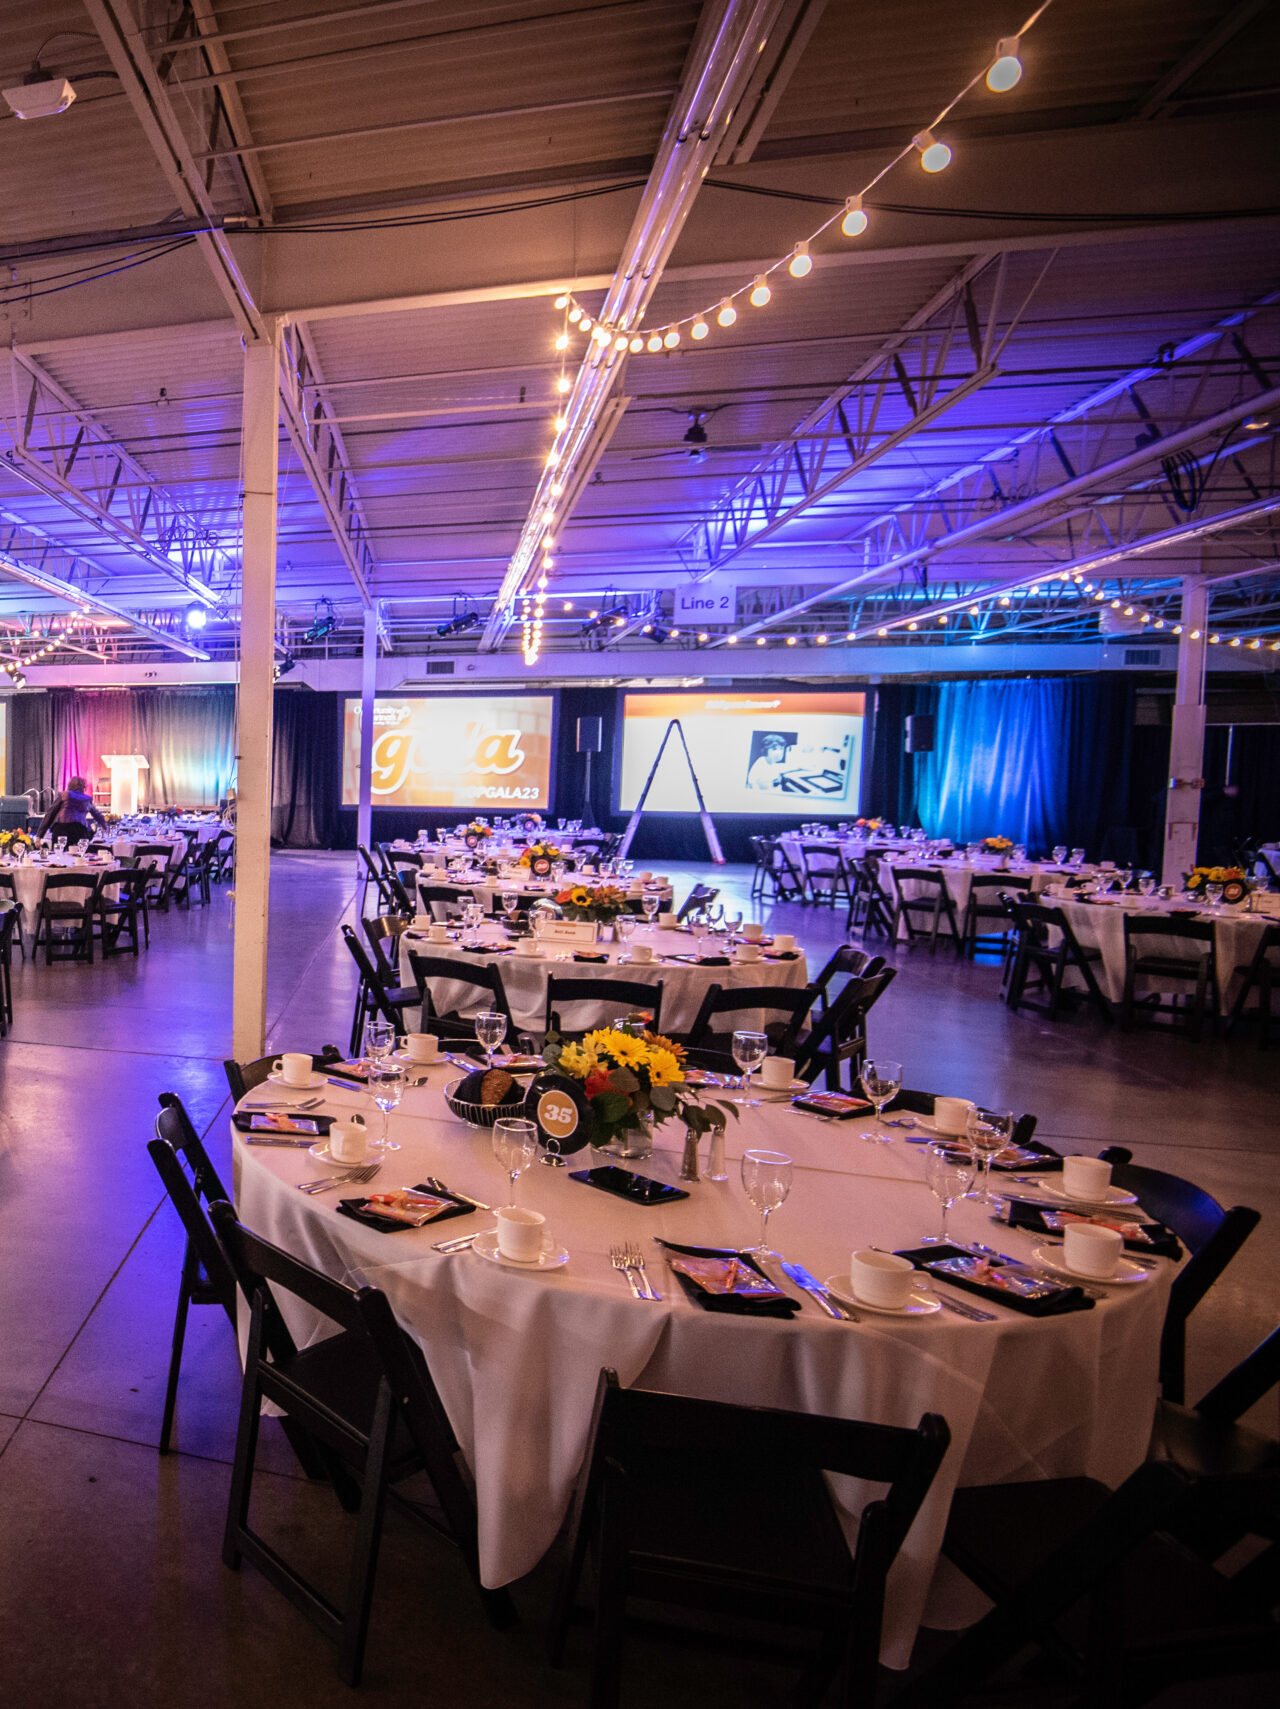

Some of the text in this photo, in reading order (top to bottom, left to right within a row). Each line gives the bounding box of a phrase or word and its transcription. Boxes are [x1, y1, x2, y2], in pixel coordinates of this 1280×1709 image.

[681, 596, 729, 610] Line 2
[544, 1104, 573, 1123] 35
